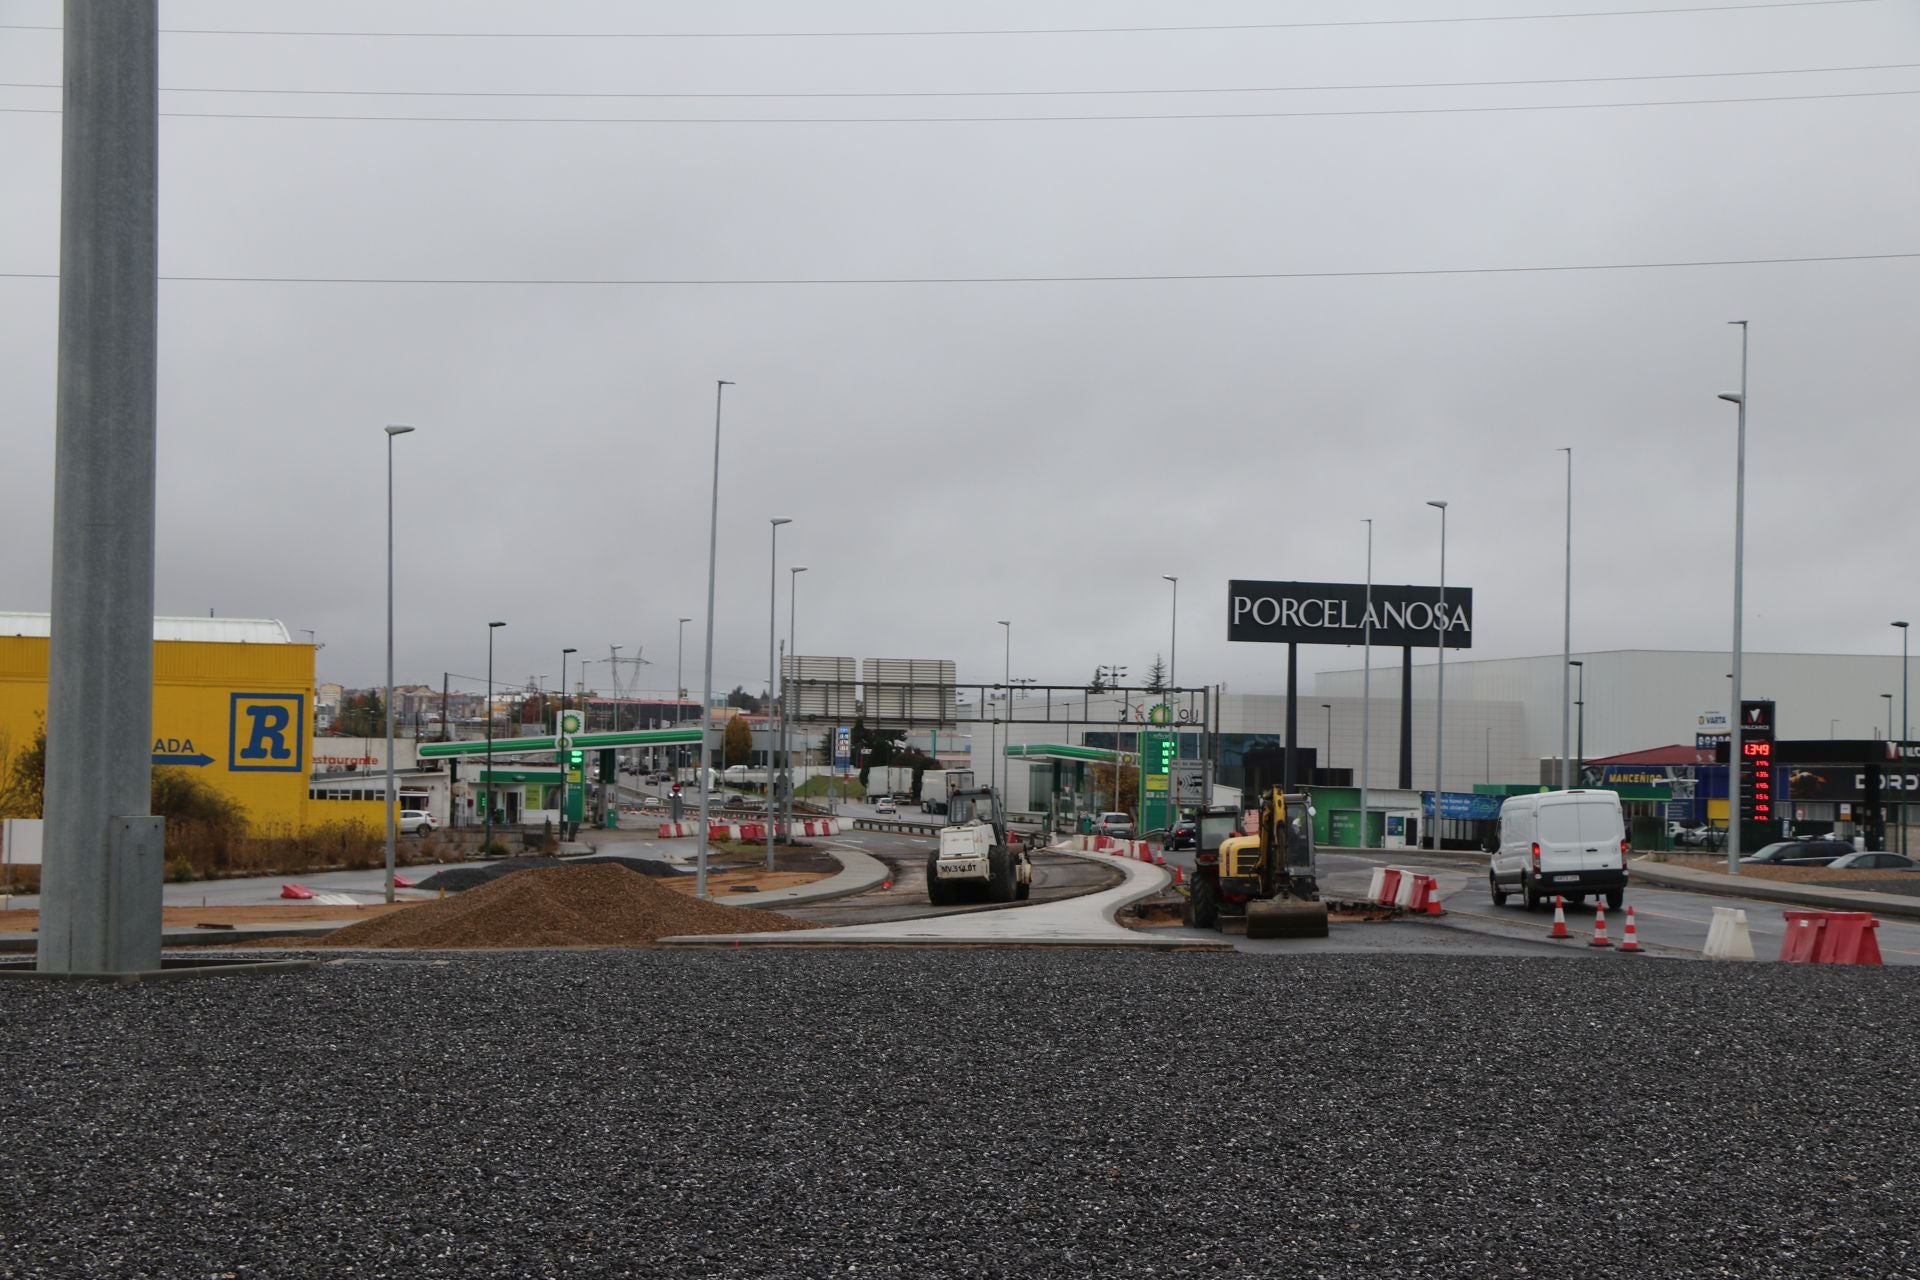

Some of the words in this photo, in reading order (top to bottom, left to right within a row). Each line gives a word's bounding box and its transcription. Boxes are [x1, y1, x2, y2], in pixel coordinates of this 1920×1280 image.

[1233, 596, 1470, 632] PORCELANOSA
[240, 705, 291, 759] R
[1744, 744, 1769, 755] 1.349
